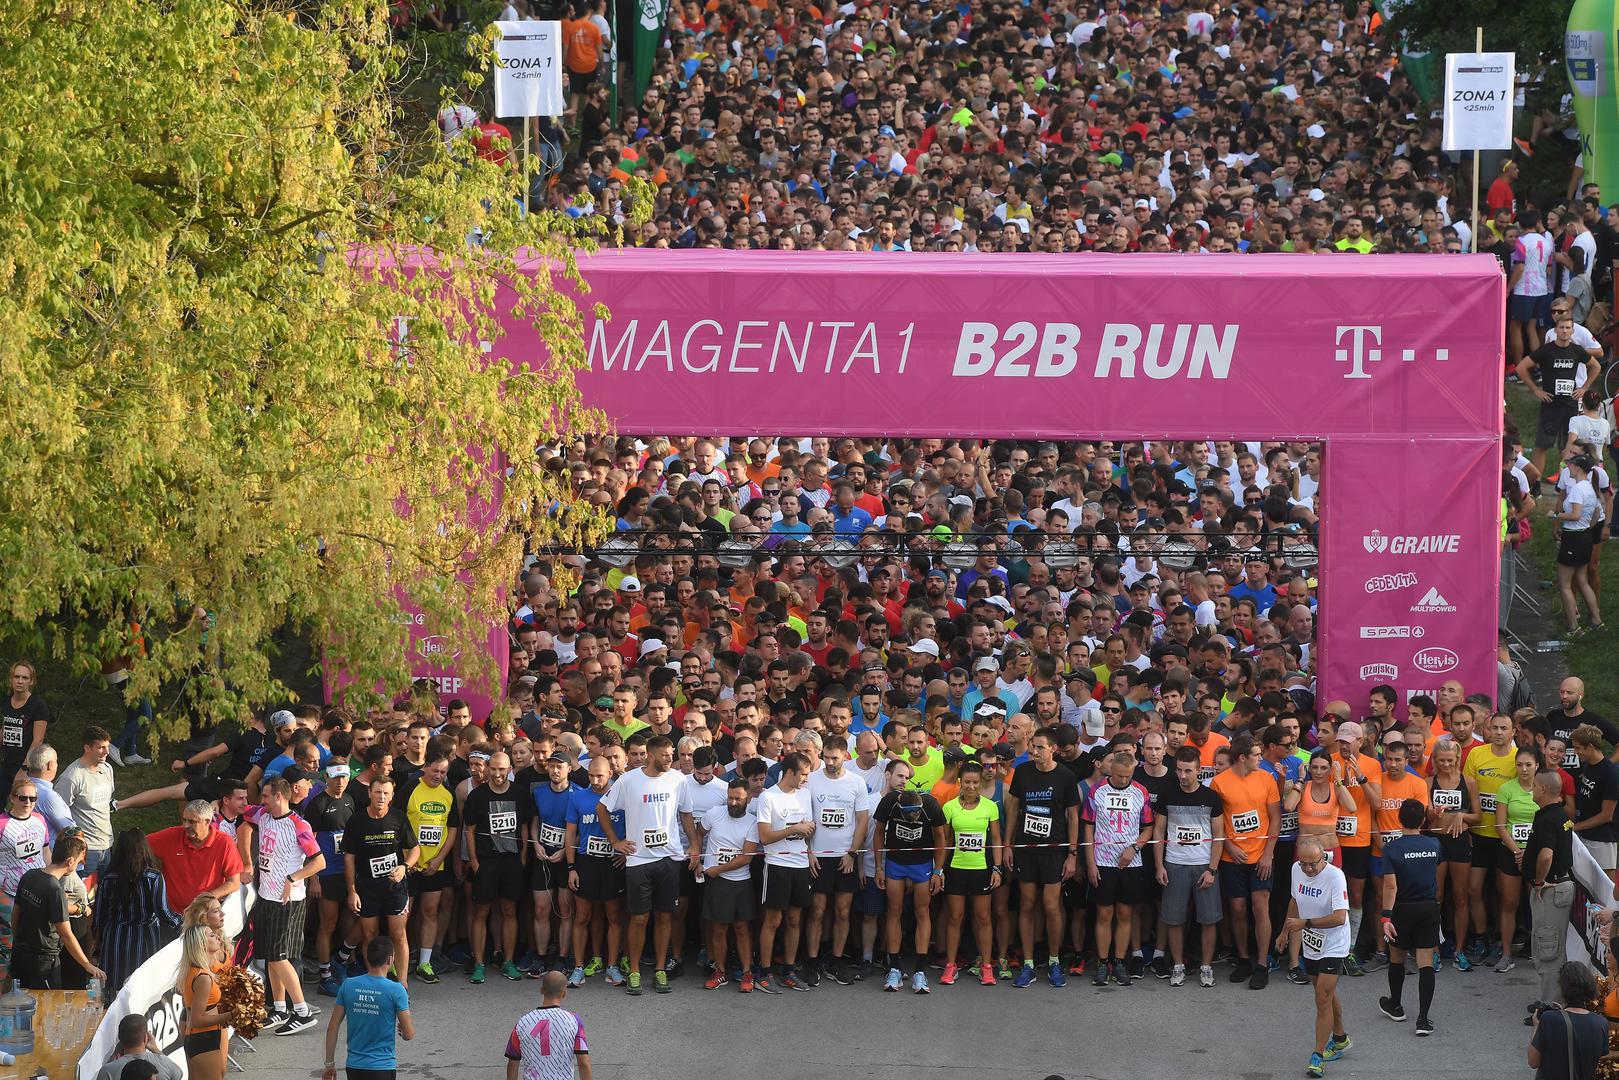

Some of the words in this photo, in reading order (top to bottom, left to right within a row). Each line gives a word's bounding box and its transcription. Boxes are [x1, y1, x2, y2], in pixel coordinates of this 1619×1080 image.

[501, 57, 541, 69] ZONA
[546, 56, 552, 68] 1
[511, 71, 542, 80] <25min
[1453, 90, 1495, 101] ZONA
[1500, 89, 1506, 101] 1
[586, 319, 881, 374] MAGENTA
[898, 322, 915, 374] 1
[952, 321, 1082, 377] B2B
[1094, 323, 1240, 379] RUN
[1553, 360, 1574, 369] KPMG
[1390, 535, 1461, 554] GRAWE
[1365, 572, 1418, 594] CEDEVITA
[1367, 628, 1409, 636] SPAR
[1418, 653, 1455, 668] Hervis
[652, 792, 670, 802] HEP
[1110, 797, 1128, 807] 176
[1434, 795, 1460, 805] 4398
[492, 817, 516, 829] 5210
[822, 813, 845, 823] 5705
[1234, 816, 1258, 829] 4449
[1026, 820, 1049, 833] 1469
[420, 831, 442, 841] 6080
[541, 828, 563, 843] 5211
[644, 832, 668, 844] 6109
[1177, 831, 1201, 841] 4450
[23, 842, 36, 853] 42
[589, 842, 613, 853] 6120
[959, 838, 983, 847] 2494
[1404, 850, 1437, 859] KONČAR
[372, 859, 397, 873] 3454
[1305, 886, 1322, 898] HEP
[1302, 931, 1323, 949] 2350
[358, 994, 376, 1003] RUN
[529, 1019, 551, 1057] 1
